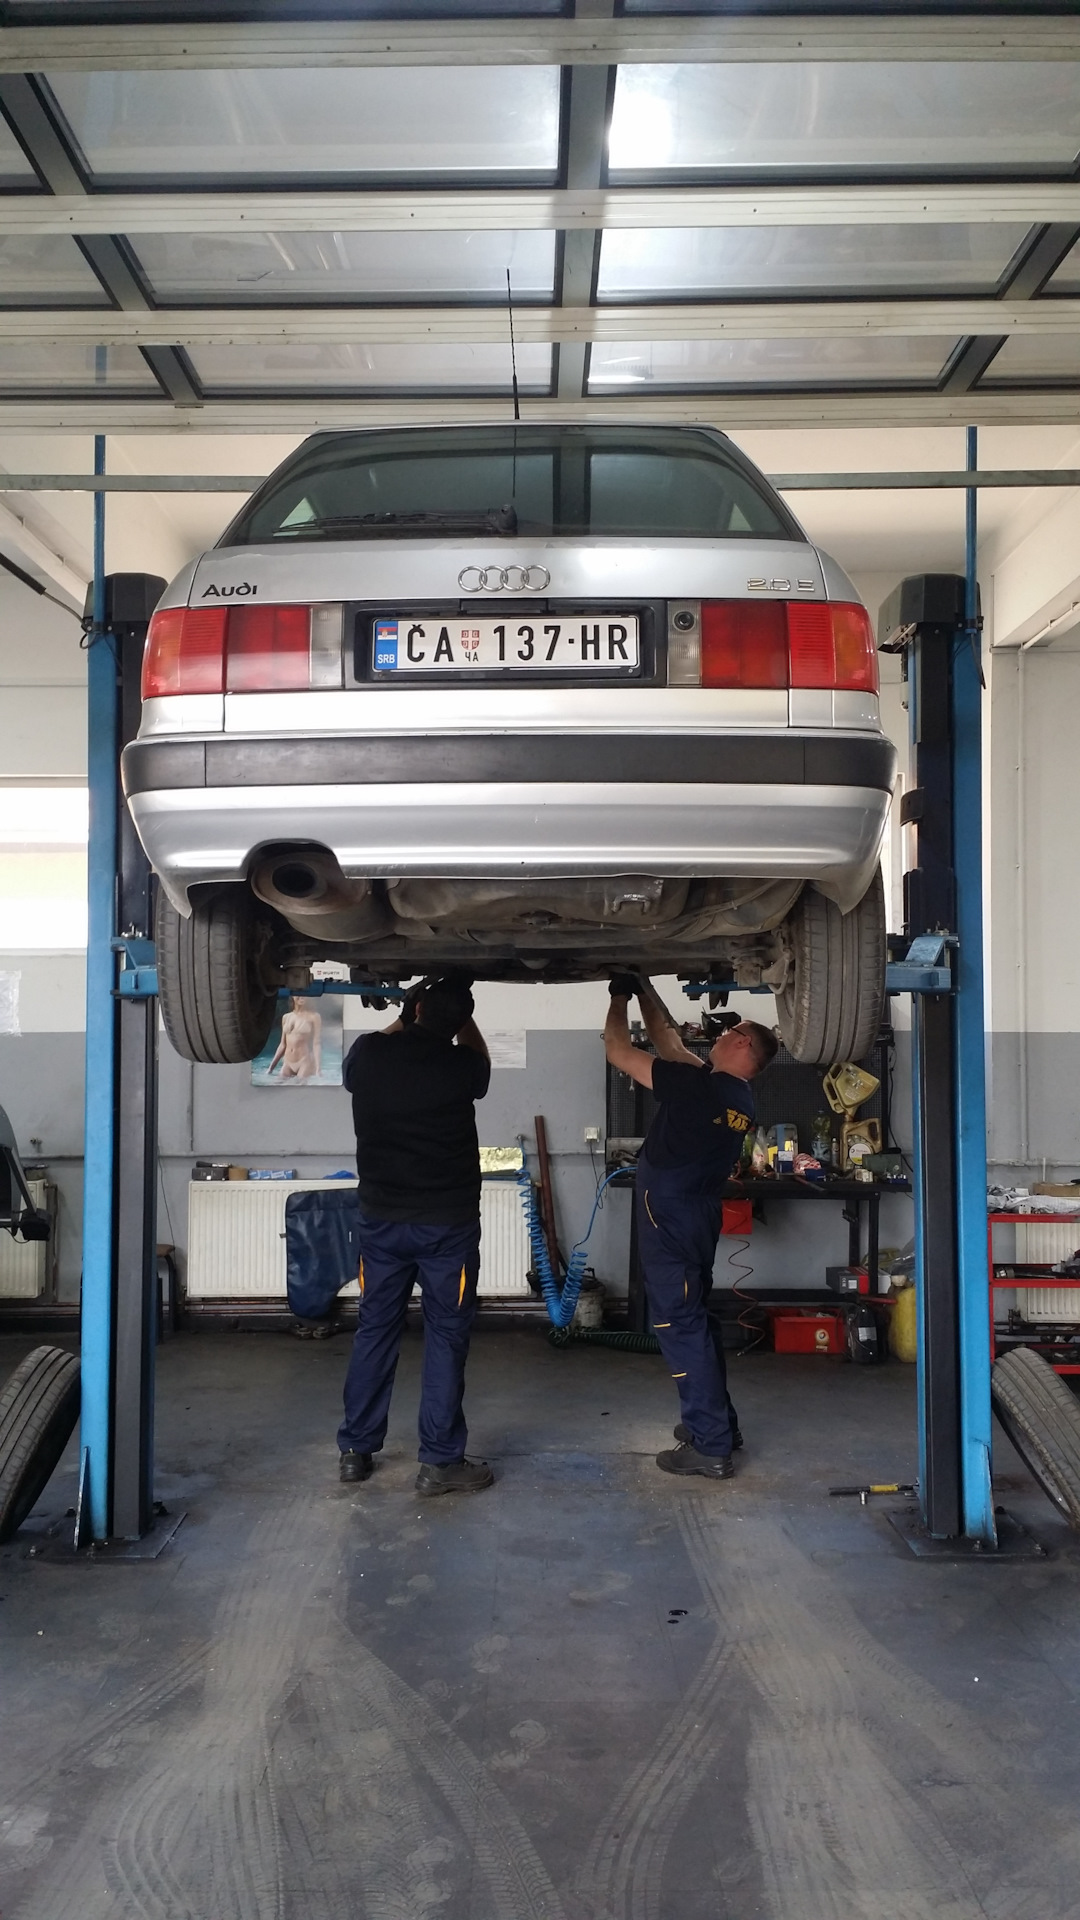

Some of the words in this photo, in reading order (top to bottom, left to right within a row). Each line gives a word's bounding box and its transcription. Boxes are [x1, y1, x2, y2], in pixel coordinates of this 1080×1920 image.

[201, 582, 258, 598] Audi
[406, 624, 455, 662] ČA
[377, 654, 395, 664] SRB
